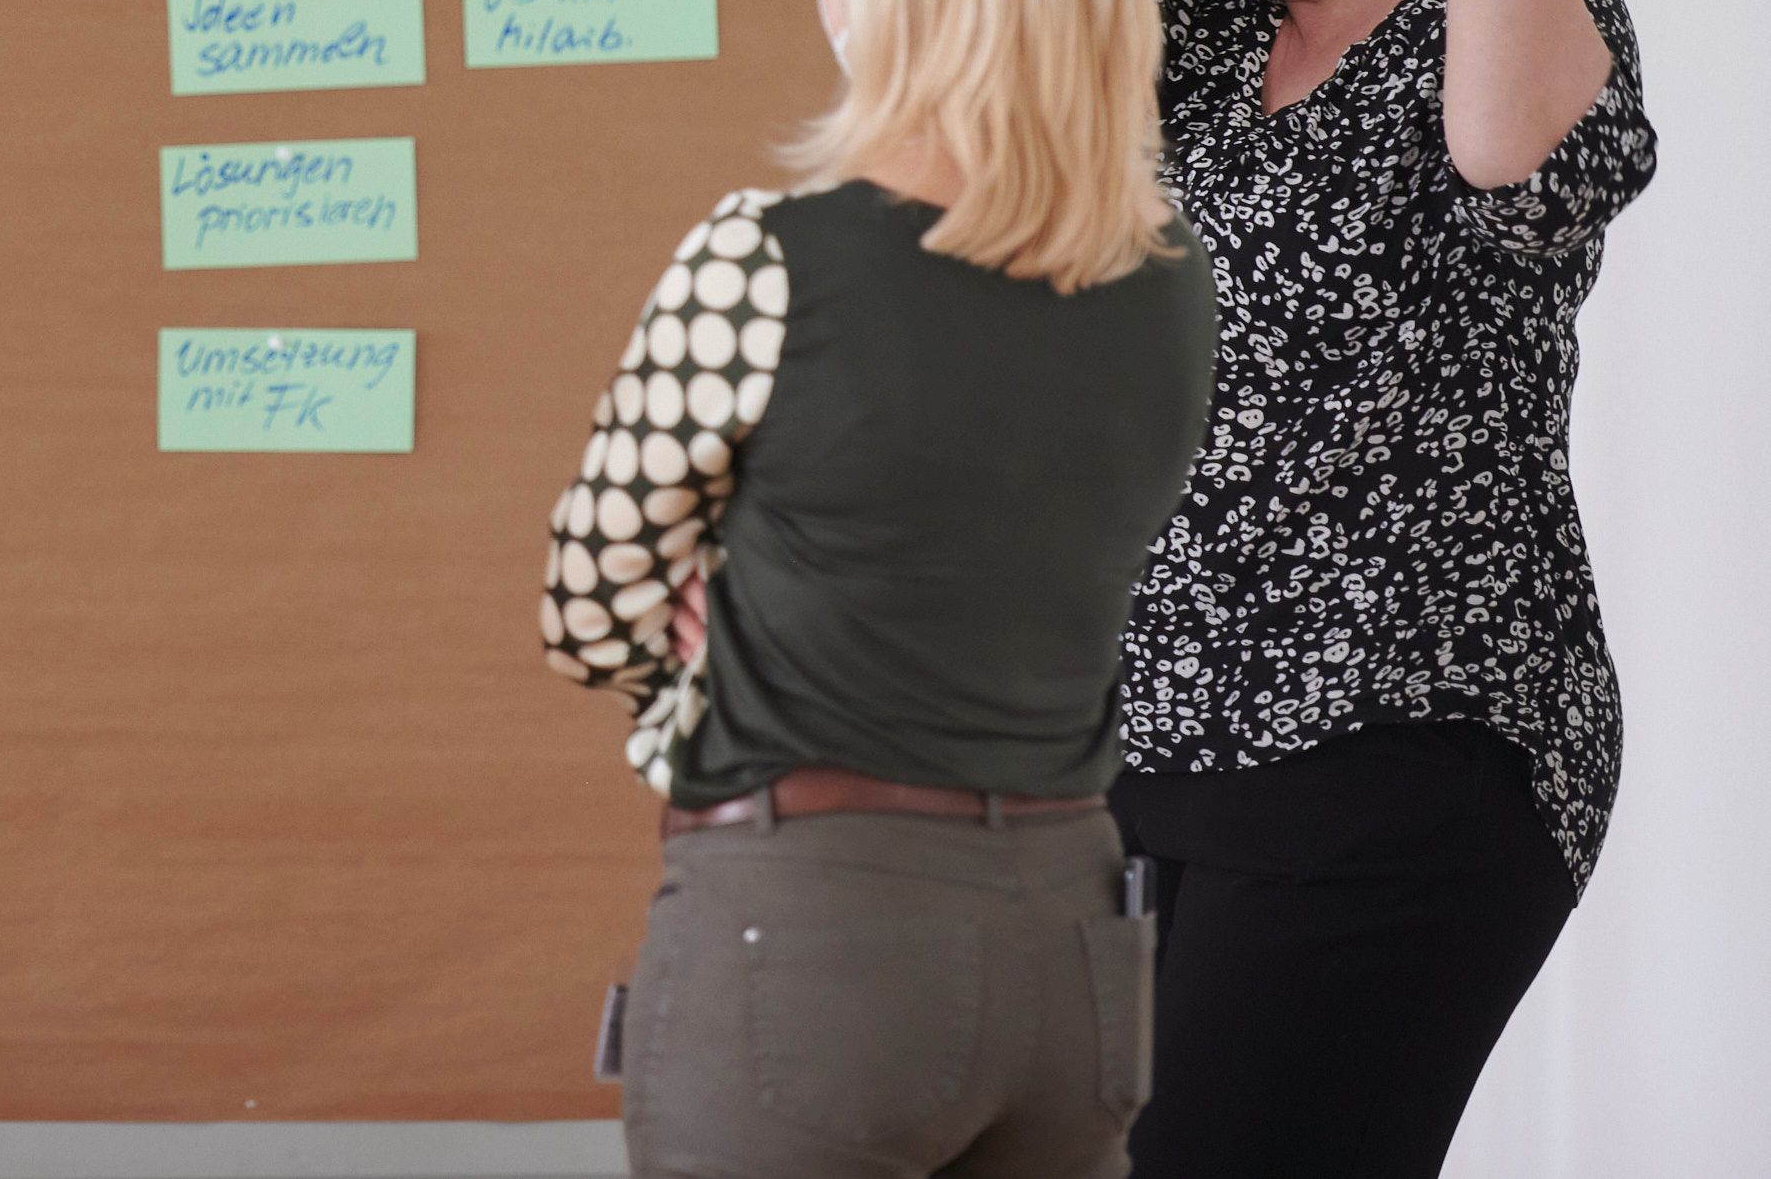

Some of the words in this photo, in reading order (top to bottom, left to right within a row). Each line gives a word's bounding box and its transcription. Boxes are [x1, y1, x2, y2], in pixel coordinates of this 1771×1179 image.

[197, 22, 388, 77] sammeln
[172, 152, 353, 200] Lösungen
[196, 194, 396, 251] priorisieren
[176, 340, 399, 390] Umsetzung
[185, 381, 255, 412] mit
